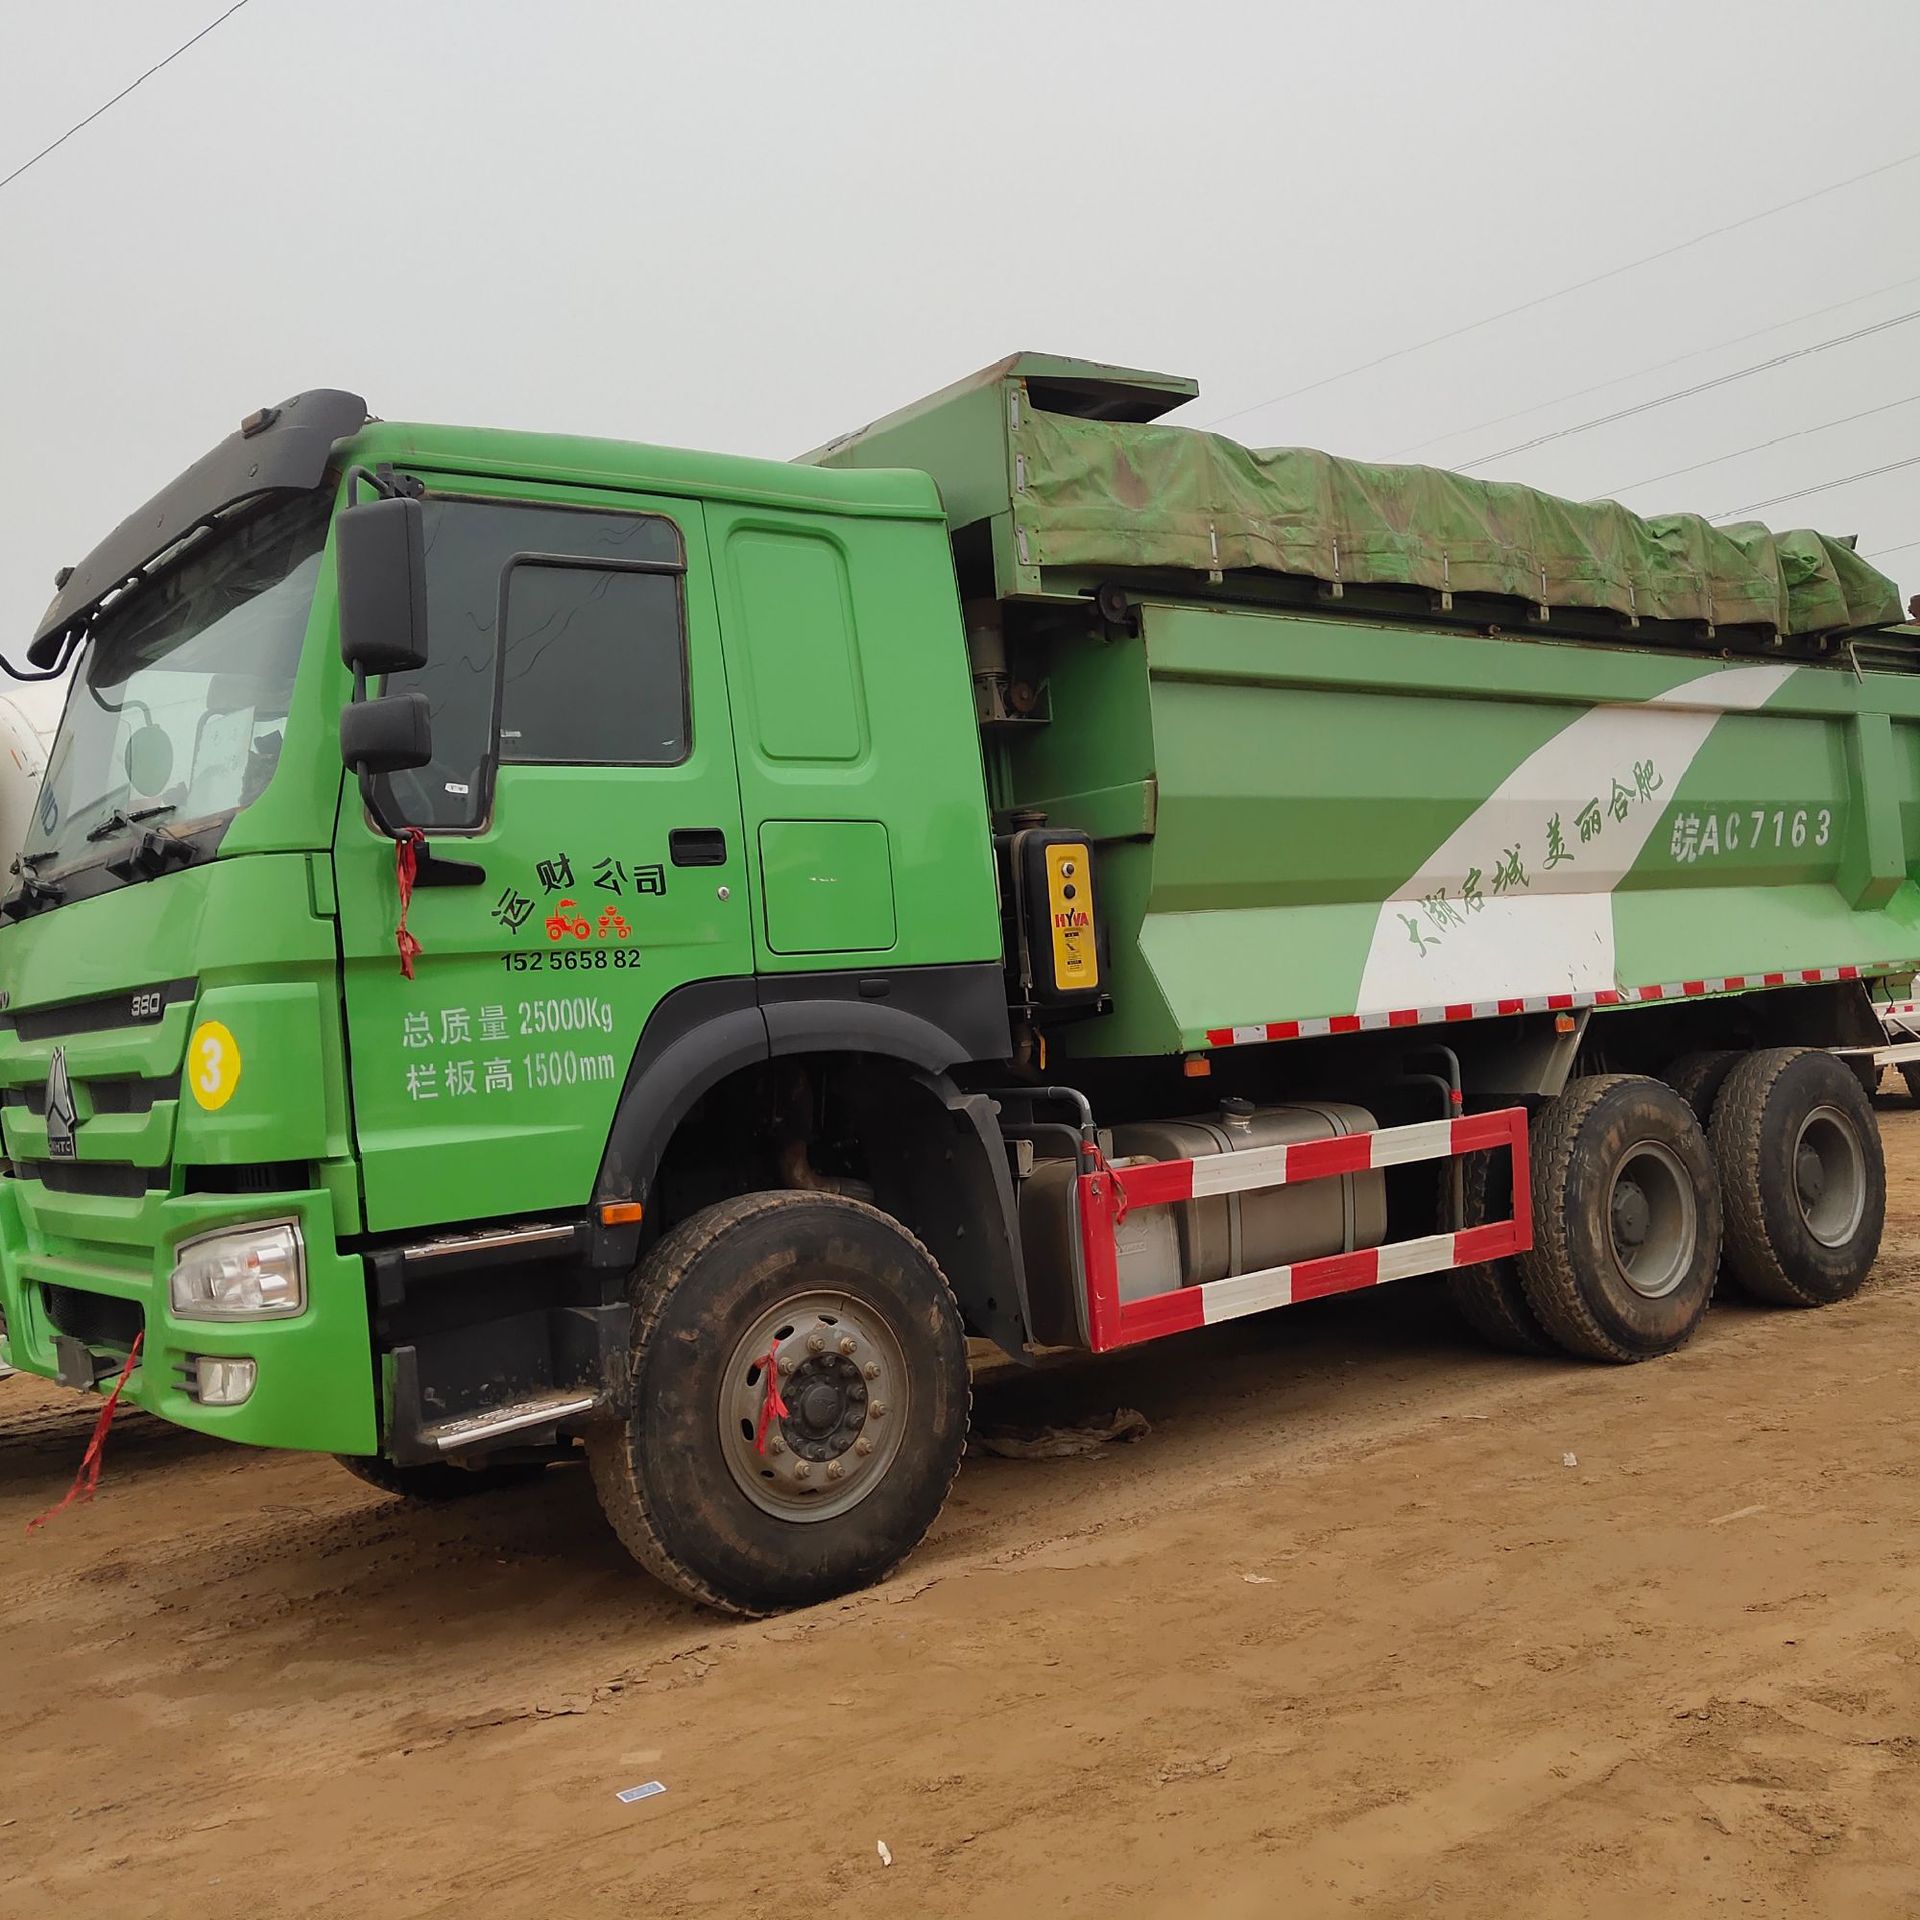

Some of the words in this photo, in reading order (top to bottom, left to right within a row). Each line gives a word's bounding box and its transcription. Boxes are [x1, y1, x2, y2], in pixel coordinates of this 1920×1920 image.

[1055, 907, 1089, 928] HYVA
[501, 952, 543, 972] 152
[549, 951, 608, 971] 5658
[613, 949, 641, 969] 82
[402, 1004, 511, 1049] 总质量
[518, 997, 613, 1035] 25000Kg
[199, 1037, 223, 1094] 3
[406, 1056, 513, 1102] 栏板高
[522, 1049, 615, 1089] 1500mm
